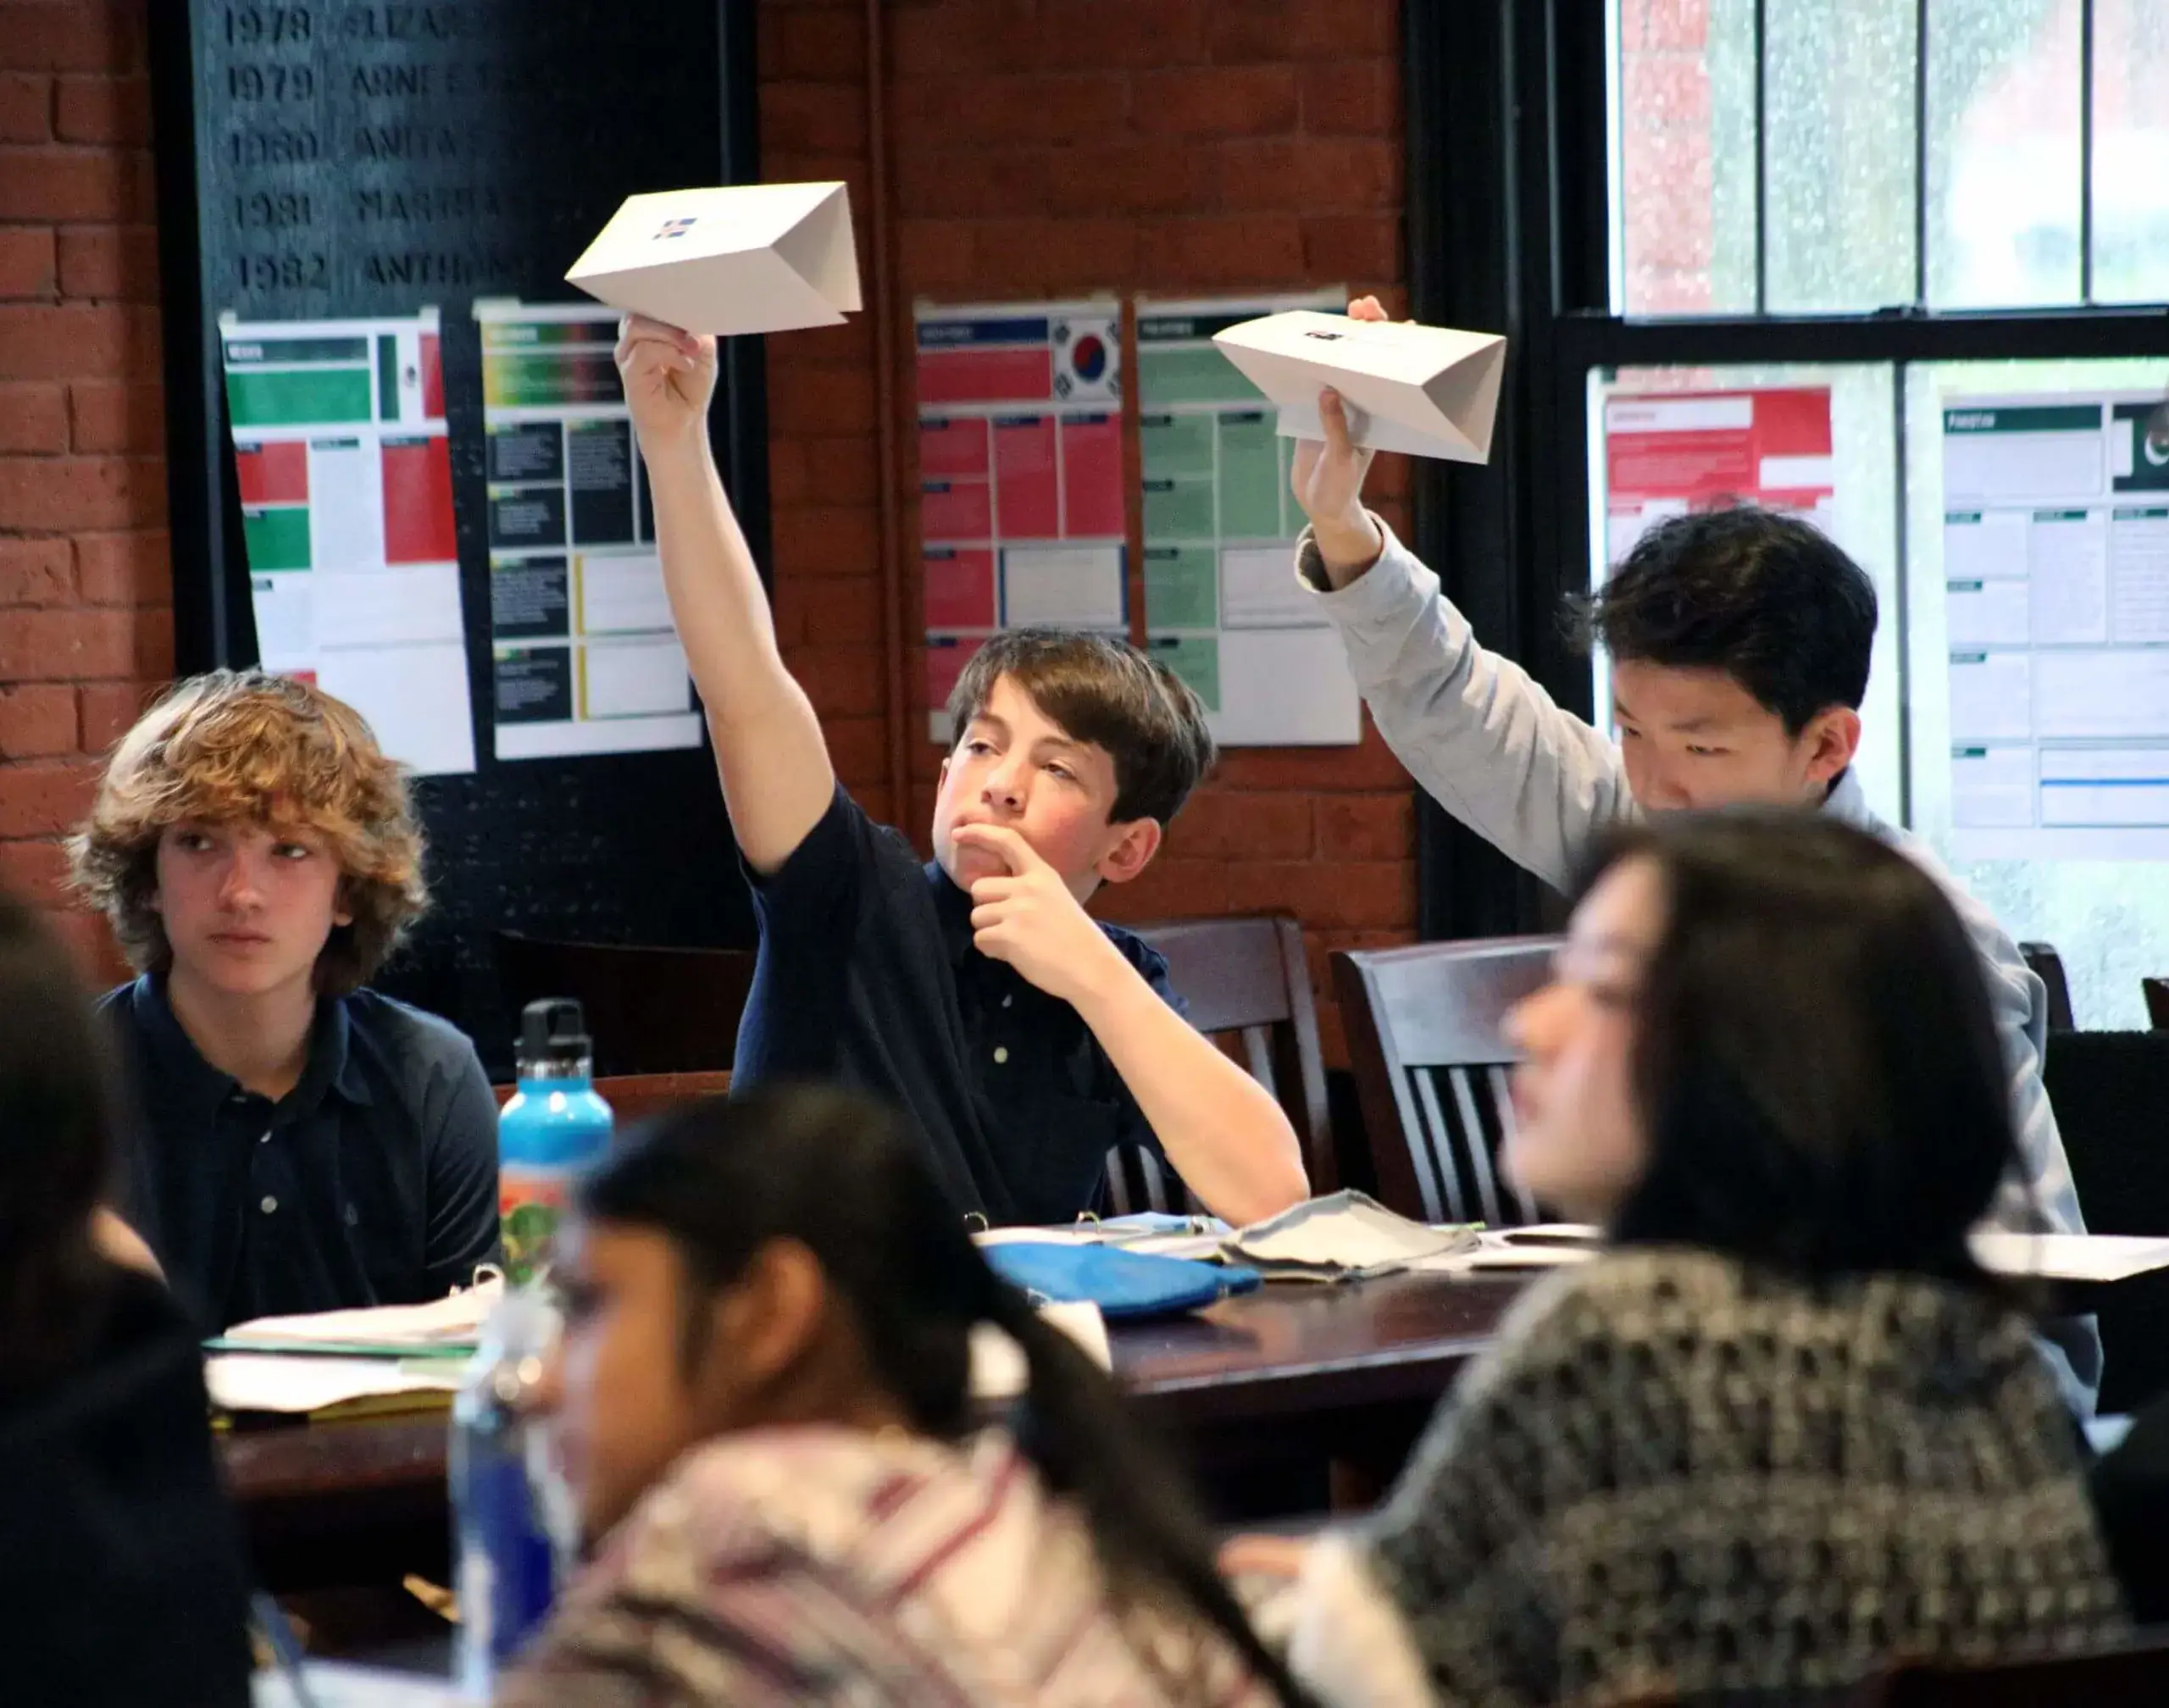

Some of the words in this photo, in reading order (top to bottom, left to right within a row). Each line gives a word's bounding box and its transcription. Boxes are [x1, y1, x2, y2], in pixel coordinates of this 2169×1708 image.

[229, 64, 314, 102] 1979
[235, 191, 311, 229] 1981
[239, 253, 329, 290] 1982
